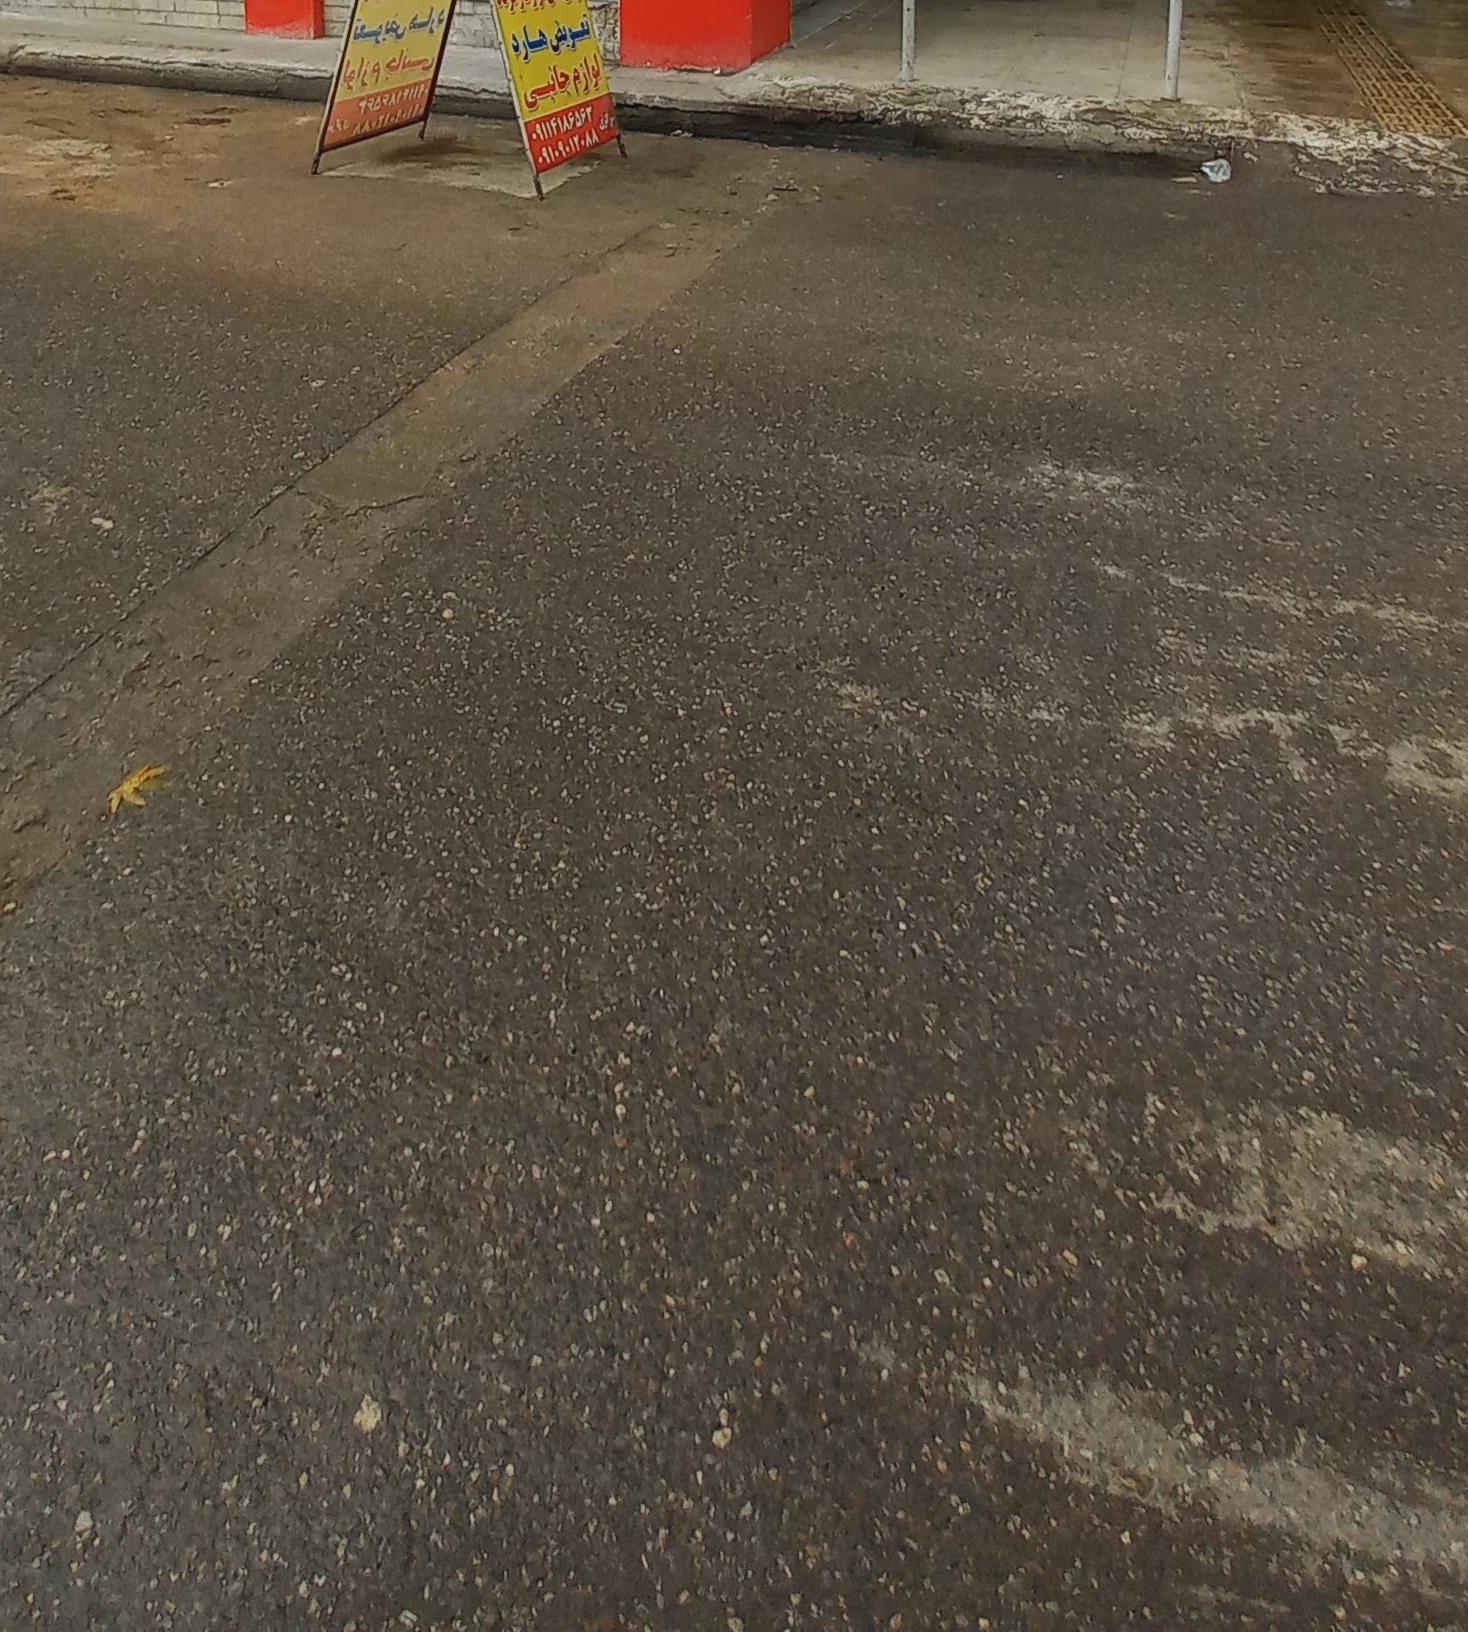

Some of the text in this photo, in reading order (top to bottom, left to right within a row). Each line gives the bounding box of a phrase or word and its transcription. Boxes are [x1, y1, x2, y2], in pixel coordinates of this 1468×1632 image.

[511, 14, 591, 62] تعویض هارد
[524, 53, 601, 111] لوازم جانبی
